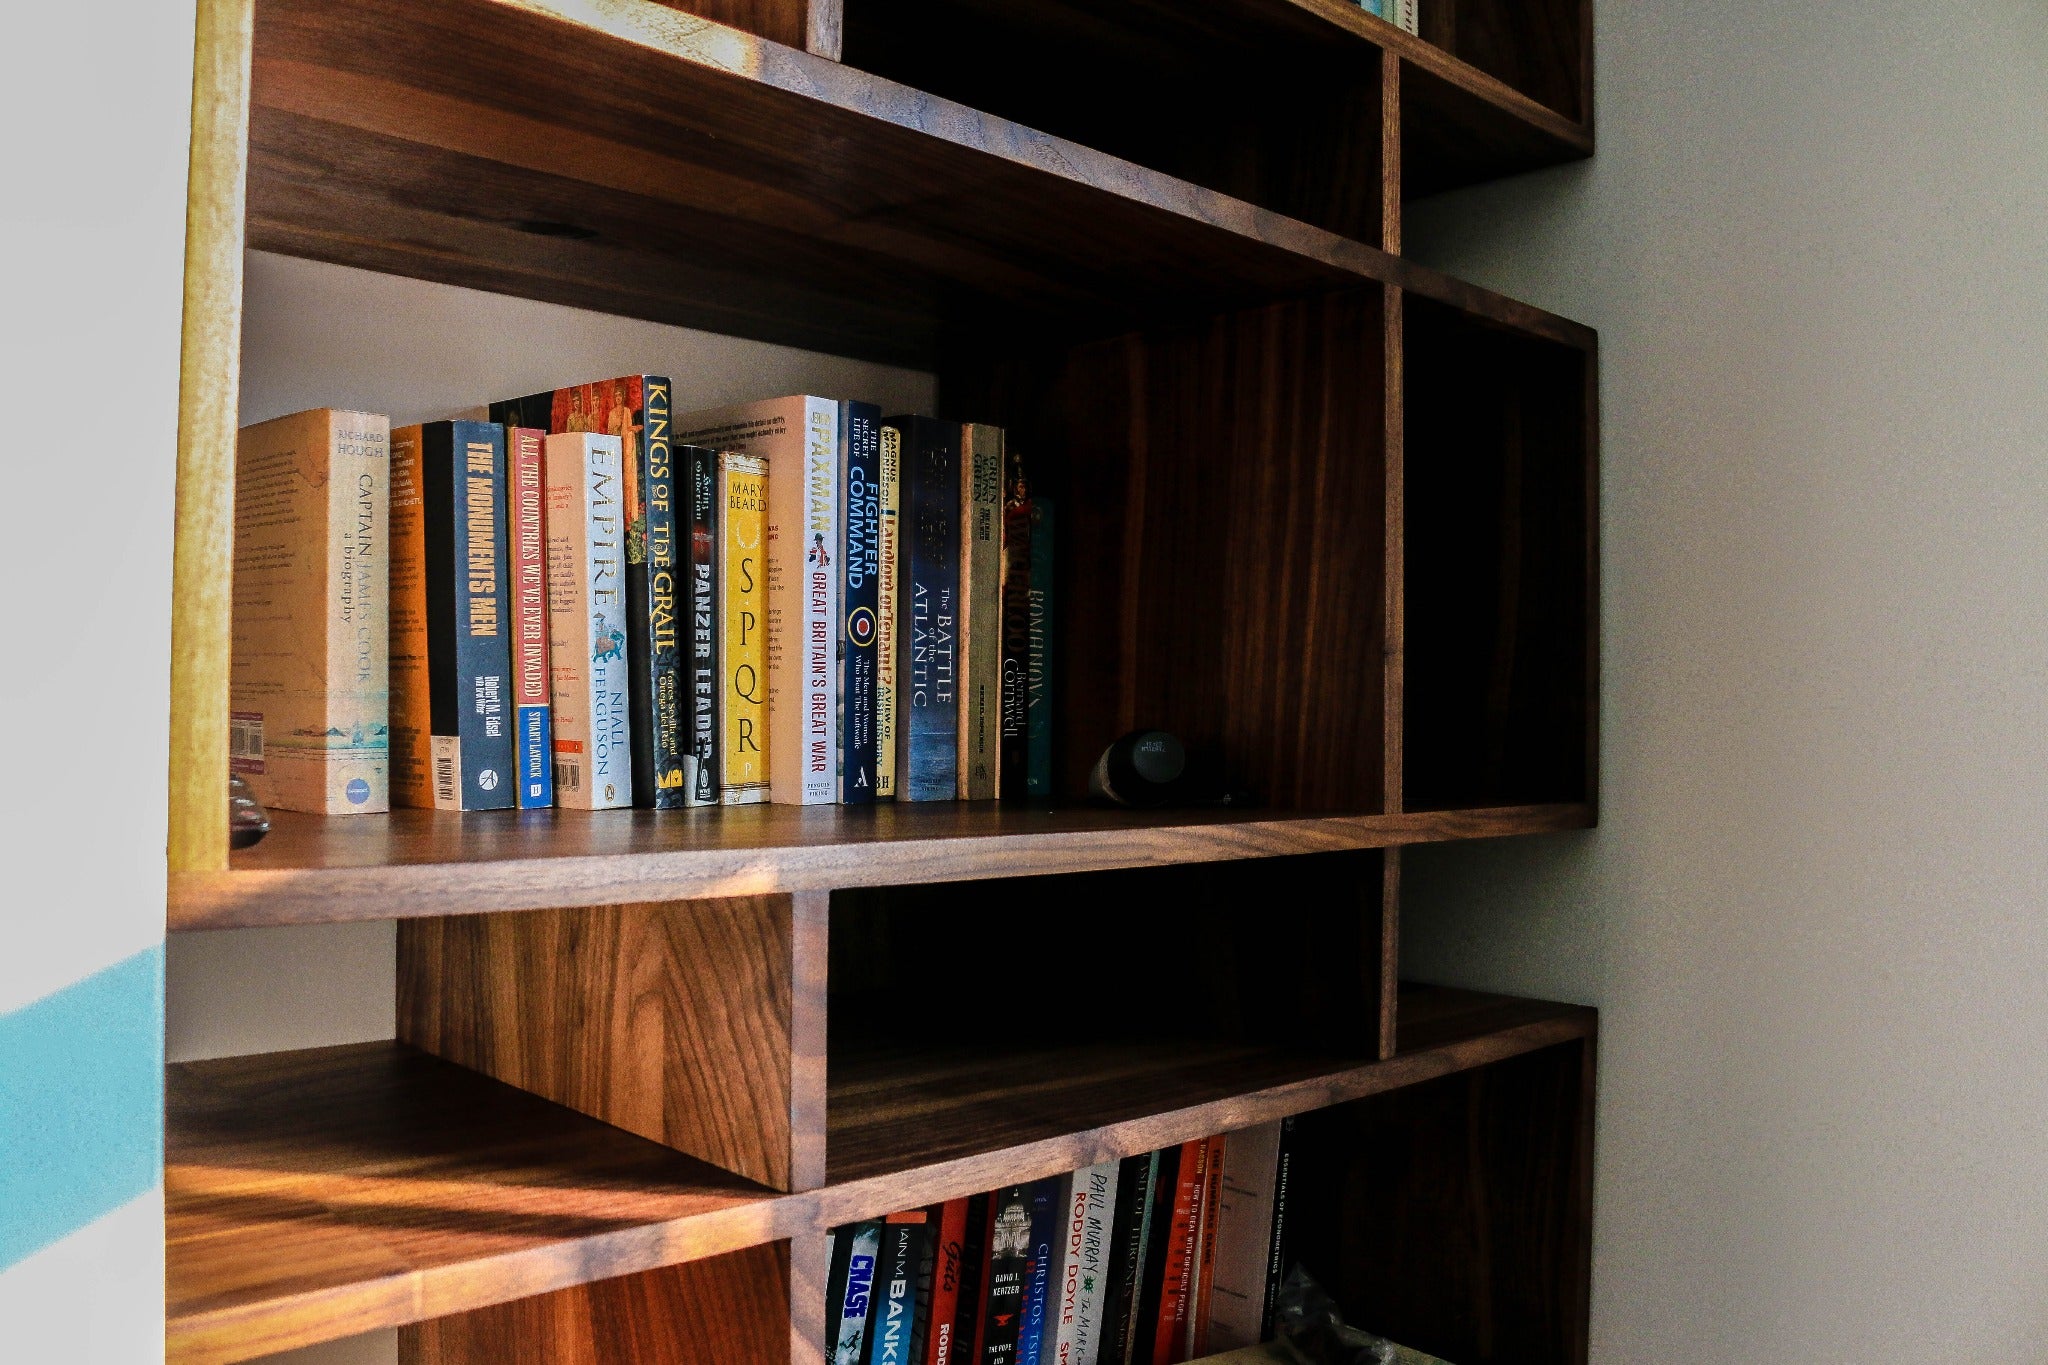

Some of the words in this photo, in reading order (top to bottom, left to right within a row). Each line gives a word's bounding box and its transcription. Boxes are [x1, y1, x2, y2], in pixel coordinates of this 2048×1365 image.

[338, 430, 384, 443] RICHARD
[521, 435, 539, 459] ALL
[648, 383, 669, 479] KINGS
[853, 418, 861, 442] LIFE
[862, 419, 870, 459] SECRET
[338, 444, 384, 457] HOUGH
[467, 442, 493, 474] THE
[853, 443, 861, 458] OF
[881, 431, 889, 505] MAGNUSSON
[521, 462, 539, 488] THE
[695, 460, 703, 520] Guderian
[701, 474, 711, 510] Heinz
[732, 481, 764, 497] MARY
[811, 427, 832, 532] PAXMAN
[974, 454, 983, 502] GREEN
[982, 457, 990, 504] AGAINST
[989, 455, 998, 505] GREEN
[359, 474, 373, 557] CAPTAIN
[652, 485, 670, 512] OF
[730, 496, 767, 512] BEARD
[467, 477, 496, 593] MONUMENTS
[521, 490, 540, 560] COUNTRIES
[592, 447, 618, 608] EMPIRE
[848, 466, 864, 589] COMMAND
[865, 482, 879, 575] FIGHTER
[879, 518, 895, 591] Landlord
[341, 546, 355, 623] biography
[356, 557, 372, 622] JAMES
[522, 563, 541, 604] WE'VE
[811, 572, 828, 615] GREAT
[941, 587, 950, 610] The
[470, 597, 497, 636] MEN
[523, 607, 542, 639] EVER
[652, 572, 675, 655] GRAIL
[695, 564, 712, 659] PANZER
[357, 626, 372, 683] COOK
[811, 621, 828, 687] BRITAIN'S
[877, 609, 893, 687] Tenant?
[914, 582, 928, 707] ATLANTIC
[929, 628, 938, 641] of
[523, 643, 543, 698] INVADED
[937, 615, 953, 703] BATTLE
[485, 676, 500, 703] Robert
[659, 677, 667, 709] Ortega
[667, 670, 675, 702] Torres
[1004, 658, 1018, 738] Cornwell
[1017, 672, 1026, 725] Bernard
[486, 704, 500, 715] M.
[486, 716, 502, 737] Edsel
[528, 711, 541, 742] STUART
[594, 668, 609, 776] FERGUSON
[611, 692, 623, 750] NIALL
[660, 711, 668, 727] del
[668, 703, 676, 734] Sevilla
[695, 669, 712, 759] LEADER
[811, 693, 827, 736] GREAT
[669, 737, 678, 756] and
[876, 720, 884, 767] HISTORY
[884, 727, 891, 740] OF
[529, 744, 542, 778] LAYCOCK
[811, 740, 827, 773] WAR
[1196, 1144, 1206, 1174] HASSON
[1211, 1149, 1220, 1168] THE
[1279, 1152, 1290, 1200] ESSENTIALS
[1089, 1173, 1107, 1209] PAUL
[1190, 1203, 1198, 1213] TO
[1191, 1184, 1201, 1200] HOW
[1206, 1173, 1218, 1230] NUMBERS
[1278, 1201, 1286, 1212] OF
[898, 1229, 910, 1257] IAIN
[1070, 1192, 1086, 1258] RODDY
[1187, 1215, 1196, 1233] DEAL
[1271, 1213, 1283, 1274] ECONOMETRICS
[1082, 1216, 1103, 1274] MURRAY
[1124, 1226, 1142, 1297] THRONES
[1185, 1236, 1194, 1254] WITH
[1204, 1233, 1213, 1266] GAME
[844, 1255, 874, 1318] CHASE
[894, 1261, 907, 1278] M.
[995, 1273, 1014, 1283] DAVID
[1032, 1243, 1048, 1326] CHRISTOS
[1179, 1256, 1191, 1292] DIFFICULT
[993, 1286, 1020, 1297] KERTZER
[1062, 1264, 1079, 1325] DOYLE
[1175, 1294, 1186, 1322] PEOPLE
[882, 1279, 907, 1365] BANK
[1075, 1315, 1091, 1355] MARK
[988, 1345, 998, 1354] THE
[999, 1343, 1012, 1352] POPE
